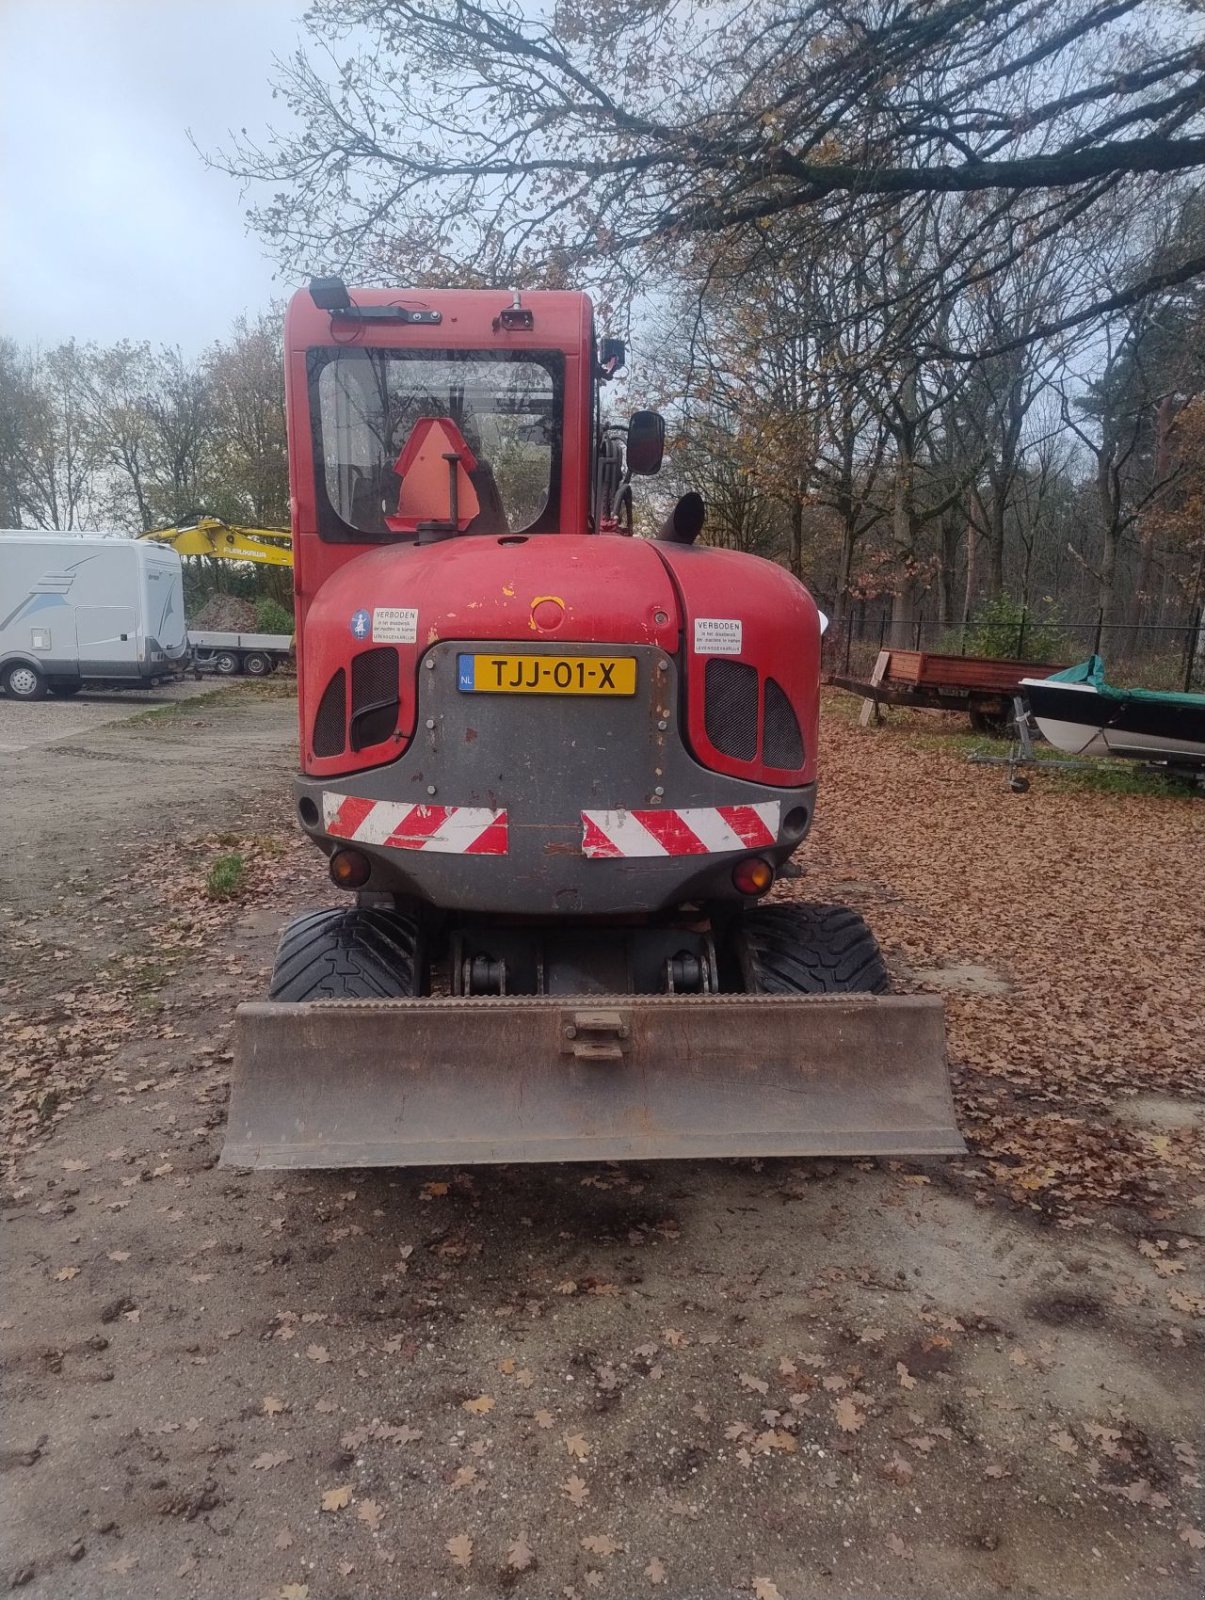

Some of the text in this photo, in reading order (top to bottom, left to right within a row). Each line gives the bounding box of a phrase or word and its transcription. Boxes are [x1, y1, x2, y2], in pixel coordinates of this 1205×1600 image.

[376, 611, 416, 619] VERBODEN
[697, 621, 740, 630] VERBODEN
[491, 660, 616, 689] TJJ-01-X
[460, 676, 473, 685] NL
